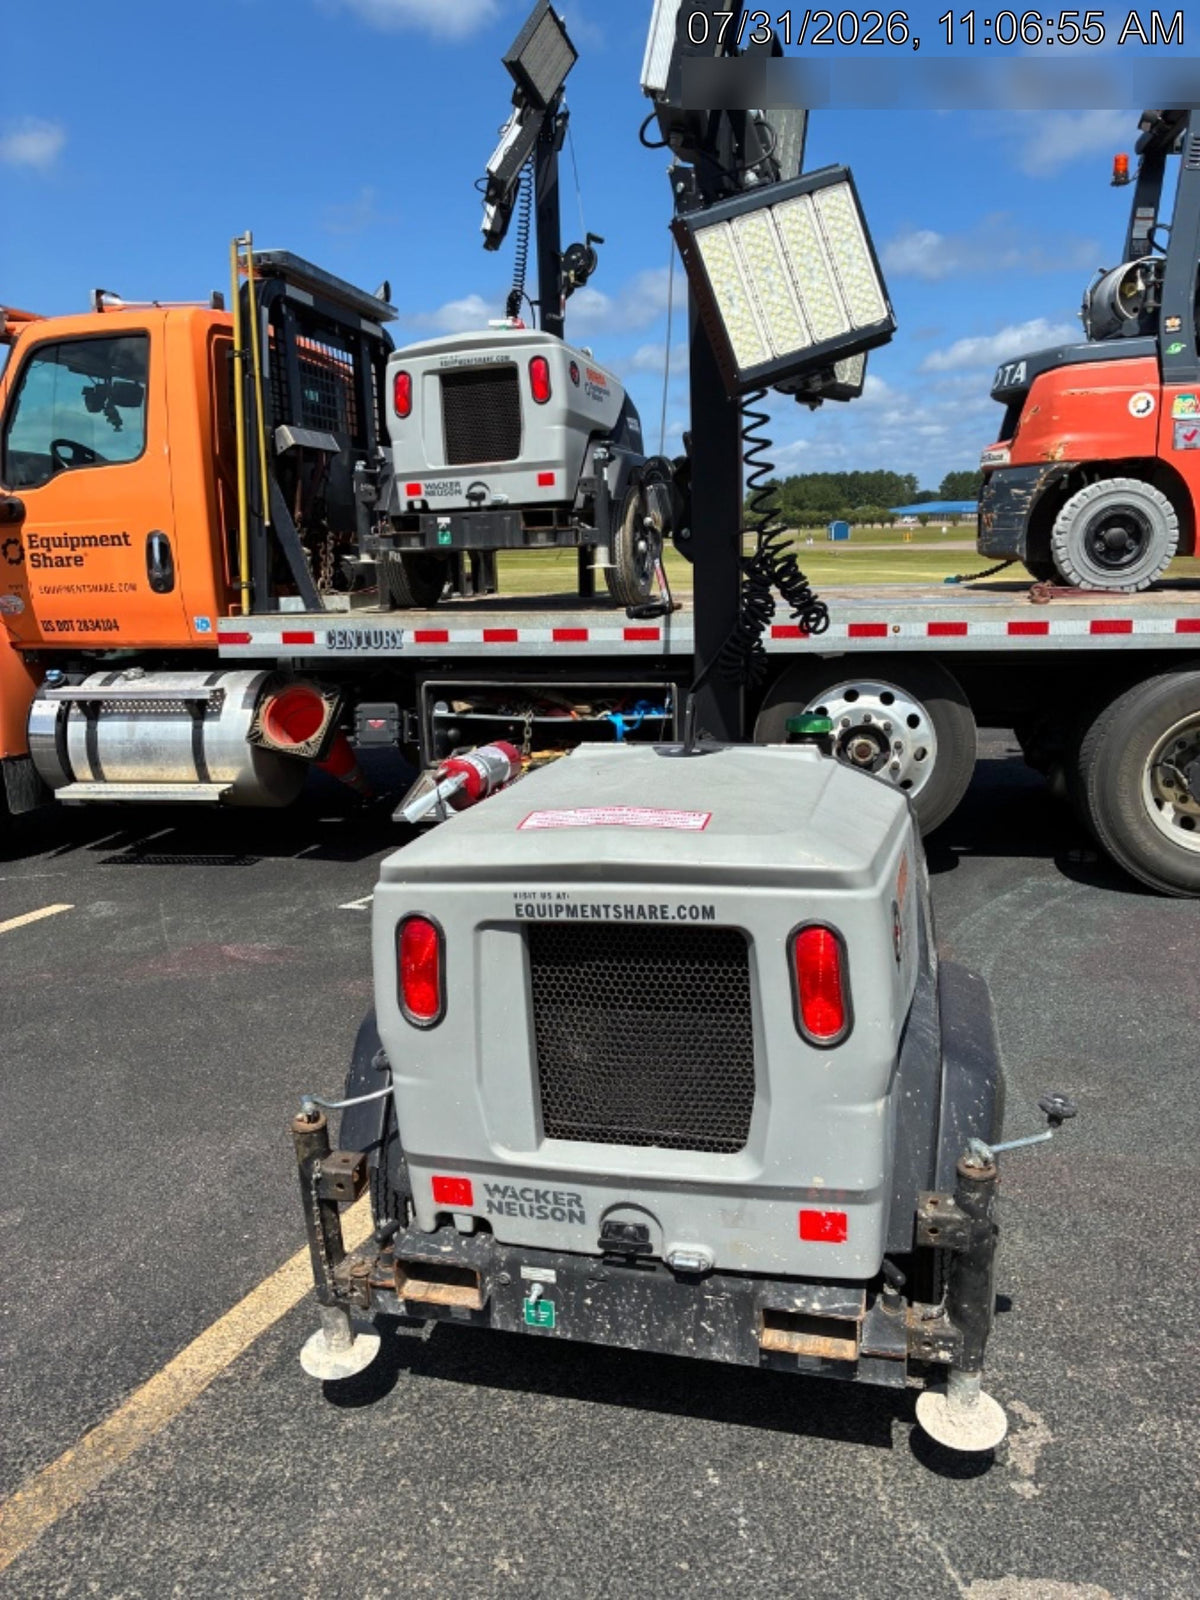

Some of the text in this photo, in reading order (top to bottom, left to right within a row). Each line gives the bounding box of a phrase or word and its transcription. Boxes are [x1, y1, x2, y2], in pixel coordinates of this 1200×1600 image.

[27, 532, 132, 551] Equipment
[30, 553, 85, 568] Share
[41, 620, 55, 631] US
[55, 620, 75, 631] DOT
[327, 629, 404, 649] CENTURY
[513, 892, 536, 900] VISIT
[540, 892, 552, 900] US
[515, 903, 715, 920] EQUIPMENTSHARE.COM
[483, 1183, 584, 1209] WACKER
[486, 1199, 586, 1225] NEUSON
